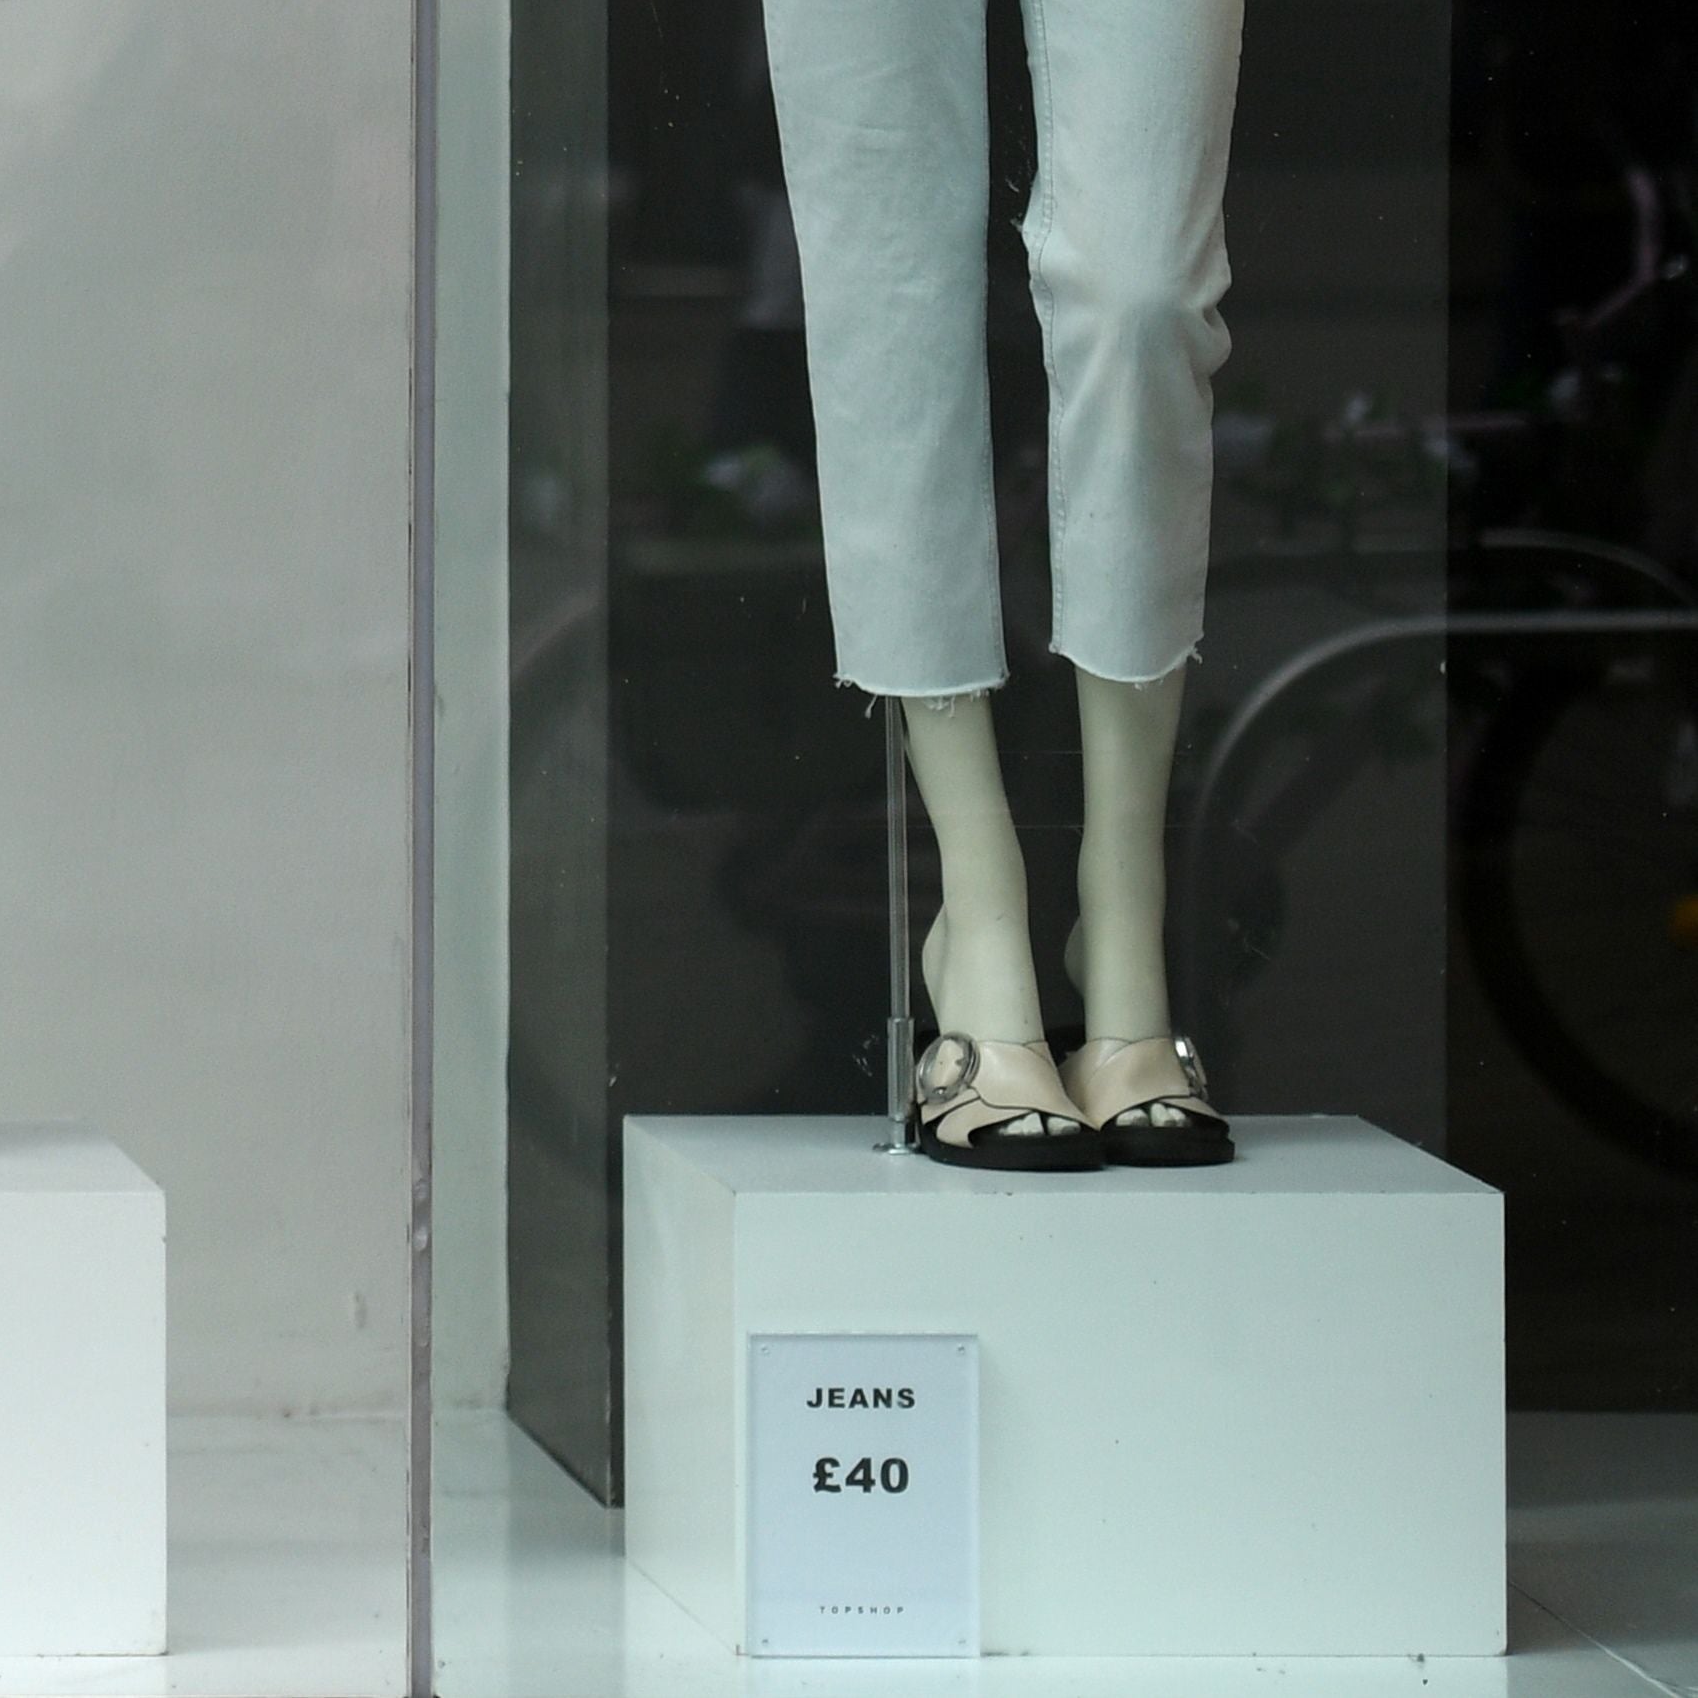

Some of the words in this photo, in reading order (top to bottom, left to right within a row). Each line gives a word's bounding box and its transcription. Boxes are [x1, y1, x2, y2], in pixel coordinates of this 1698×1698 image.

[805, 1387, 916, 1409] JEANS
[812, 1456, 910, 1494] £40
[819, 1605, 905, 1615] TOPSHOP
